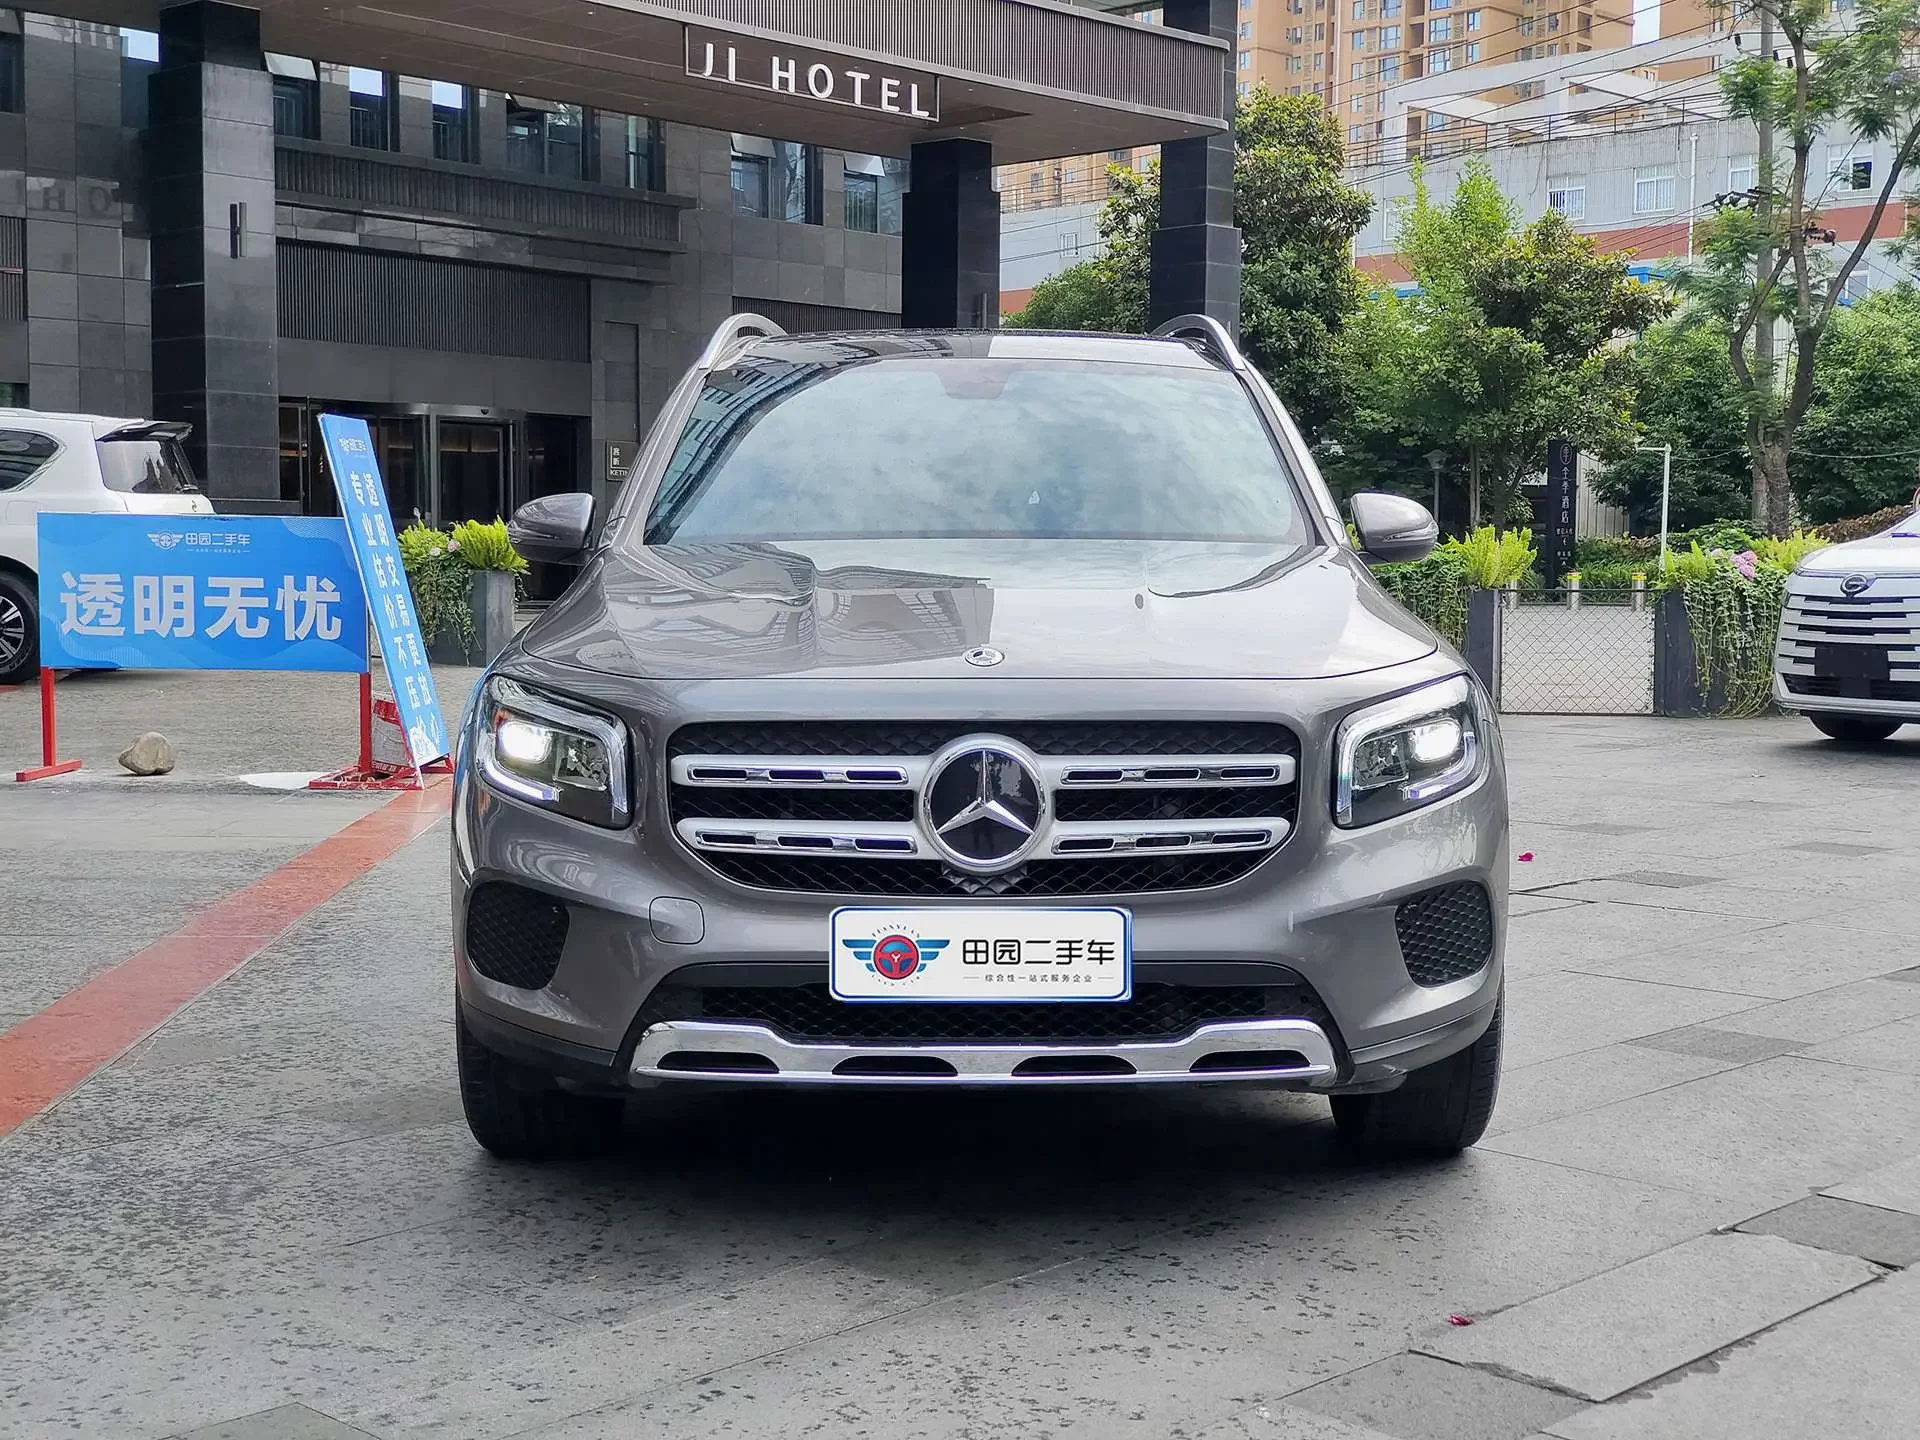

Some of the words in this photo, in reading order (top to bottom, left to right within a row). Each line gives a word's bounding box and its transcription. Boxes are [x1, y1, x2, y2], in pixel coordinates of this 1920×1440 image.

[702, 42, 736, 82] JI
[772, 55, 929, 117] HOTEL
[185, 532, 251, 546] 田园二手车
[60, 570, 342, 640] 透明无忧
[962, 939, 1115, 965] 田园二手车
[984, 973, 1093, 983] 综合性一站式服务企业
